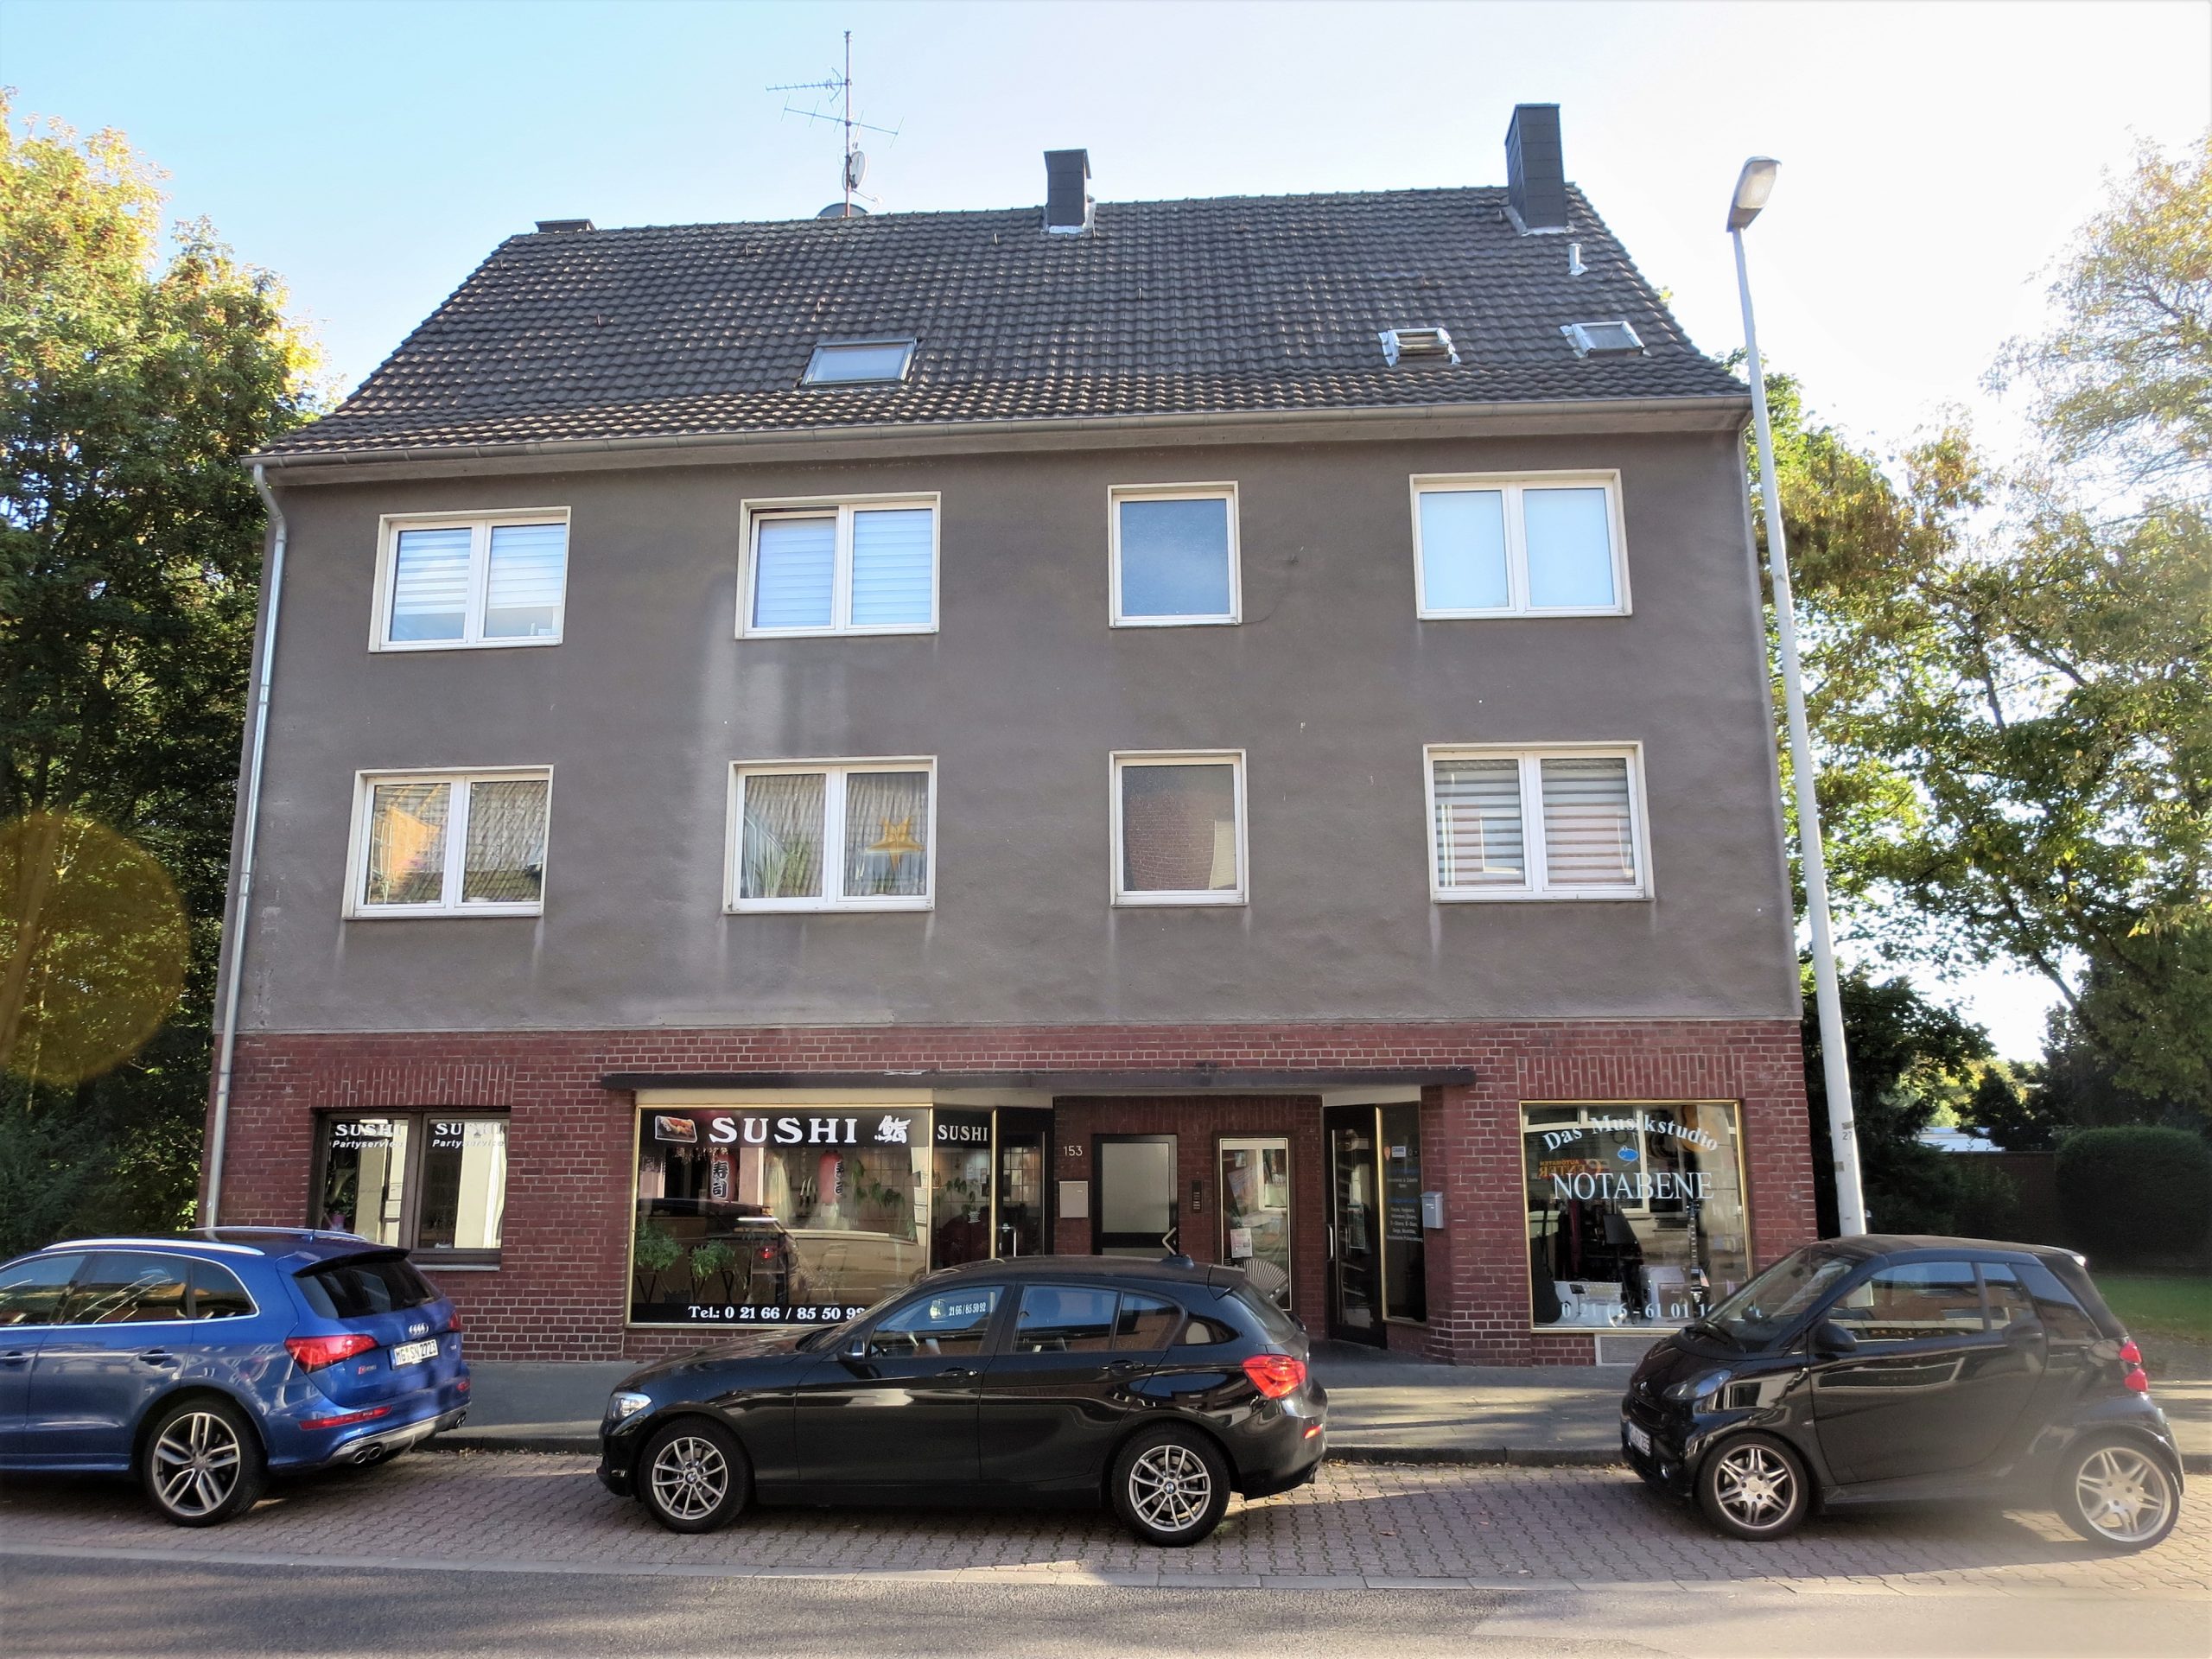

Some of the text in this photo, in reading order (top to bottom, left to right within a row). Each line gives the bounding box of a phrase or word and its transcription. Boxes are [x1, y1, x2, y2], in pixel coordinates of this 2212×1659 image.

[335, 1123, 401, 1137] SUSHI
[709, 1117, 857, 1144] SUSHI
[938, 1124, 988, 1141] SUSHI
[1542, 1114, 1718, 1152] Das Musikstudio
[332, 1141, 404, 1150] Partyservice
[1064, 1145, 1084, 1157] 153
[1551, 1172, 1715, 1200] NOTABENE
[688, 1306, 720, 1319] Tel.:
[724, 1306, 734, 1319] 0
[740, 1306, 756, 1319] 21
[760, 1306, 780, 1319] 66
[785, 1306, 792, 1320] /
[797, 1307, 817, 1320] 85
[821, 1307, 841, 1320] 50
[1562, 1302, 1571, 1319] 0
[1645, 1302, 1662, 1319] 61
[1671, 1302, 1690, 1319] 01
